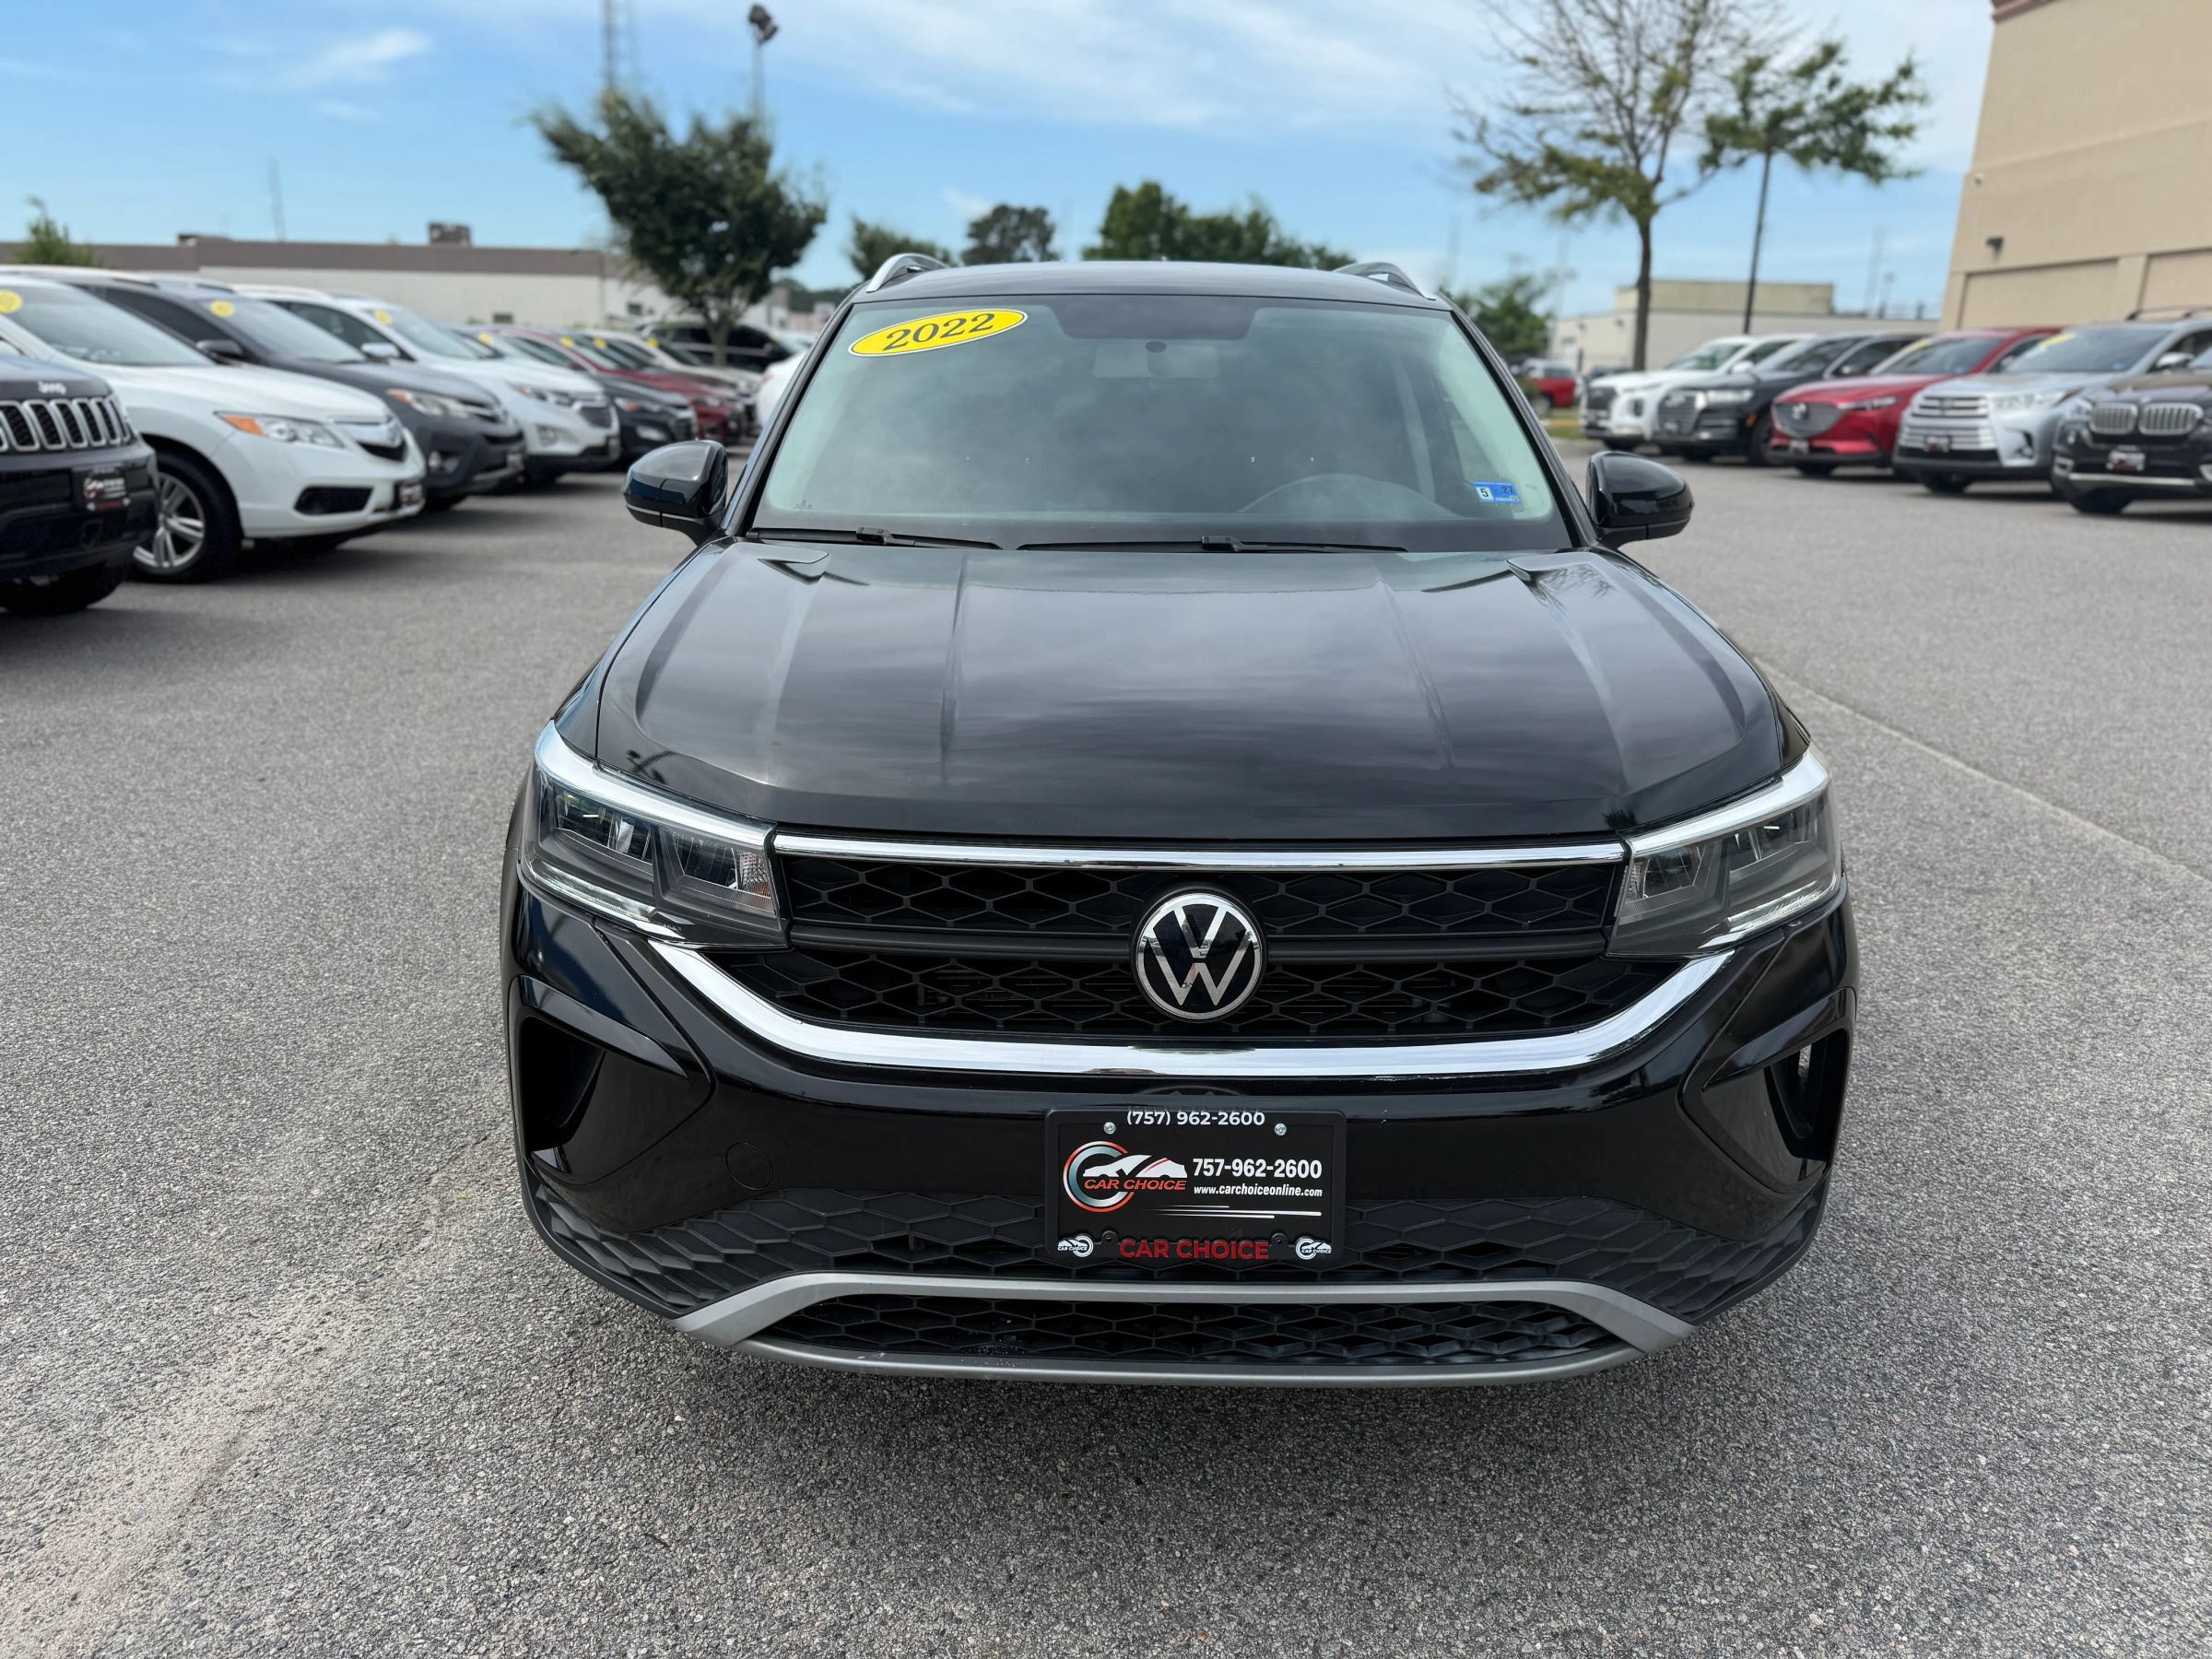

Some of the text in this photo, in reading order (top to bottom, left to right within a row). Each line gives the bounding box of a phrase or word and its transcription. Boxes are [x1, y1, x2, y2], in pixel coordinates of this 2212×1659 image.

[882, 312, 995, 351] 2022
[1479, 488, 1489, 498] 5
[1126, 1111, 1265, 1126] (757) 962-2600
[1193, 1158, 1323, 1179] 757-962-2600
[1084, 1179, 1188, 1191] CAR CHOICE
[1194, 1183, 1324, 1197] www.carchoiceonline.com
[1120, 1240, 1269, 1260] CAR CHOICE
